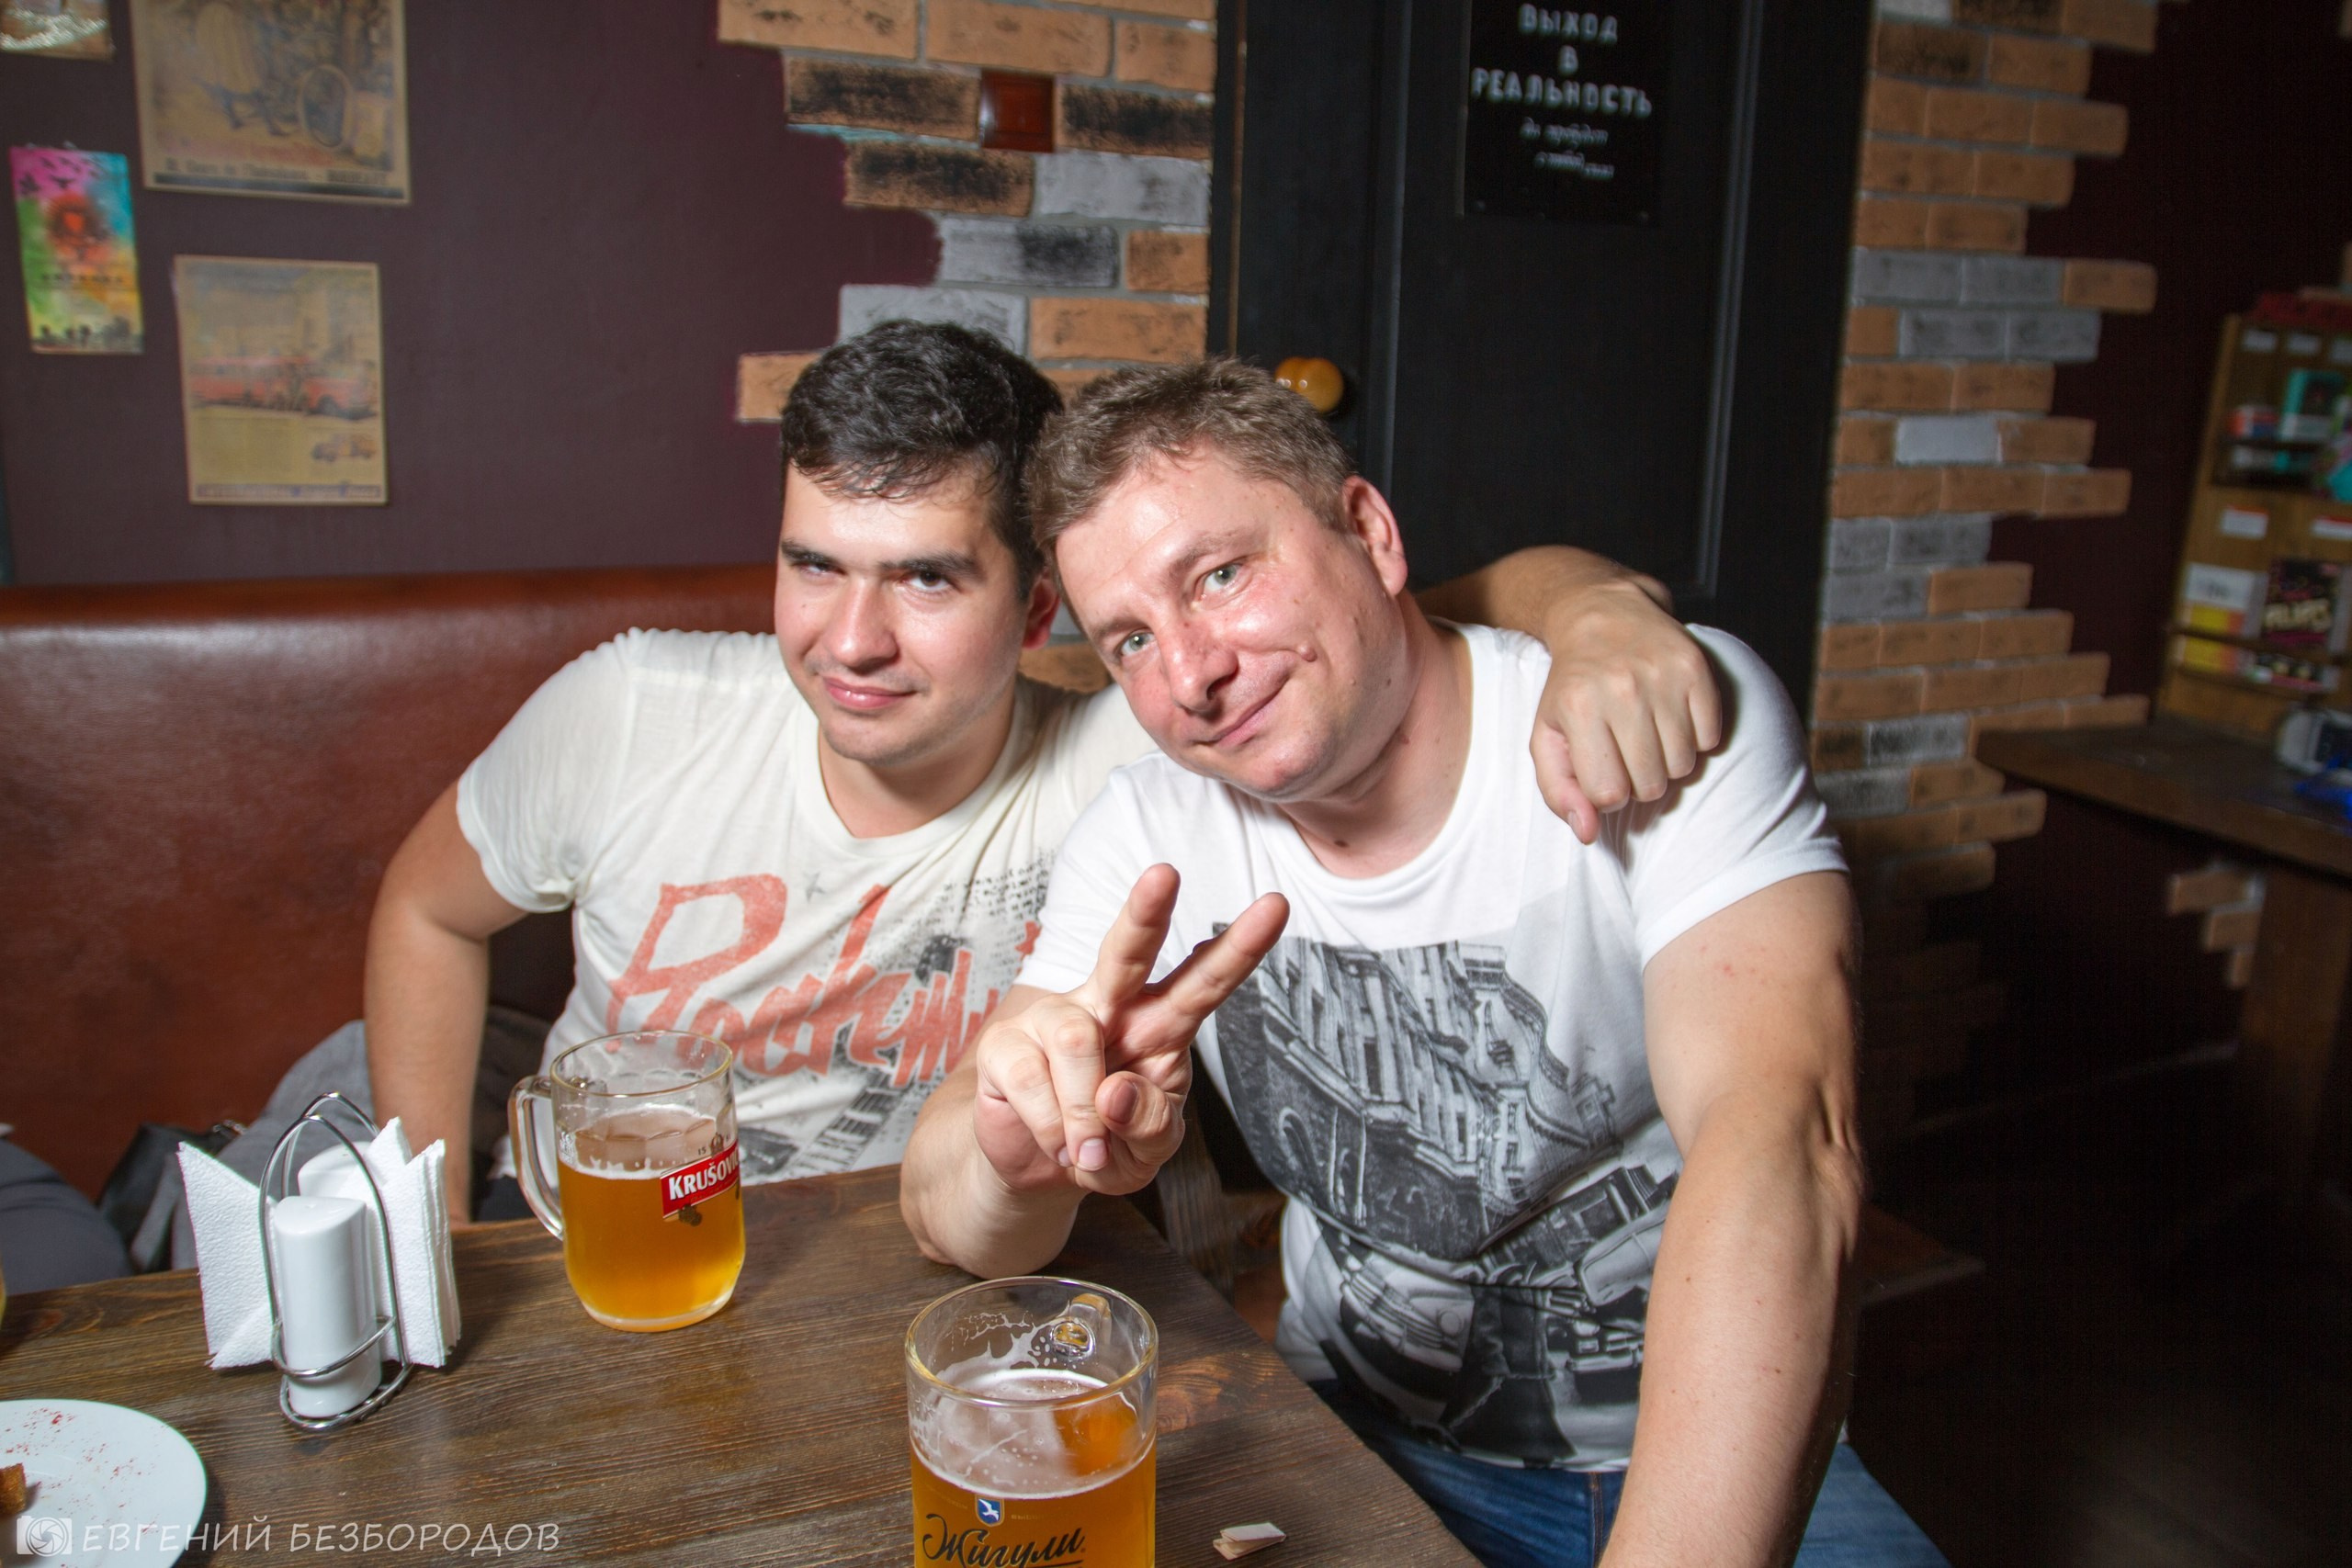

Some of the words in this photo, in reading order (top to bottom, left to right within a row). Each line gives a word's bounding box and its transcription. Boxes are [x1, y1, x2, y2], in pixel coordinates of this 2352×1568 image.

[1519, 3, 1618, 44] ВЫХОД
[1471, 67, 1652, 118] РЕАЛЬНОСТЬ
[922, 1513, 1086, 1568] Жигули
